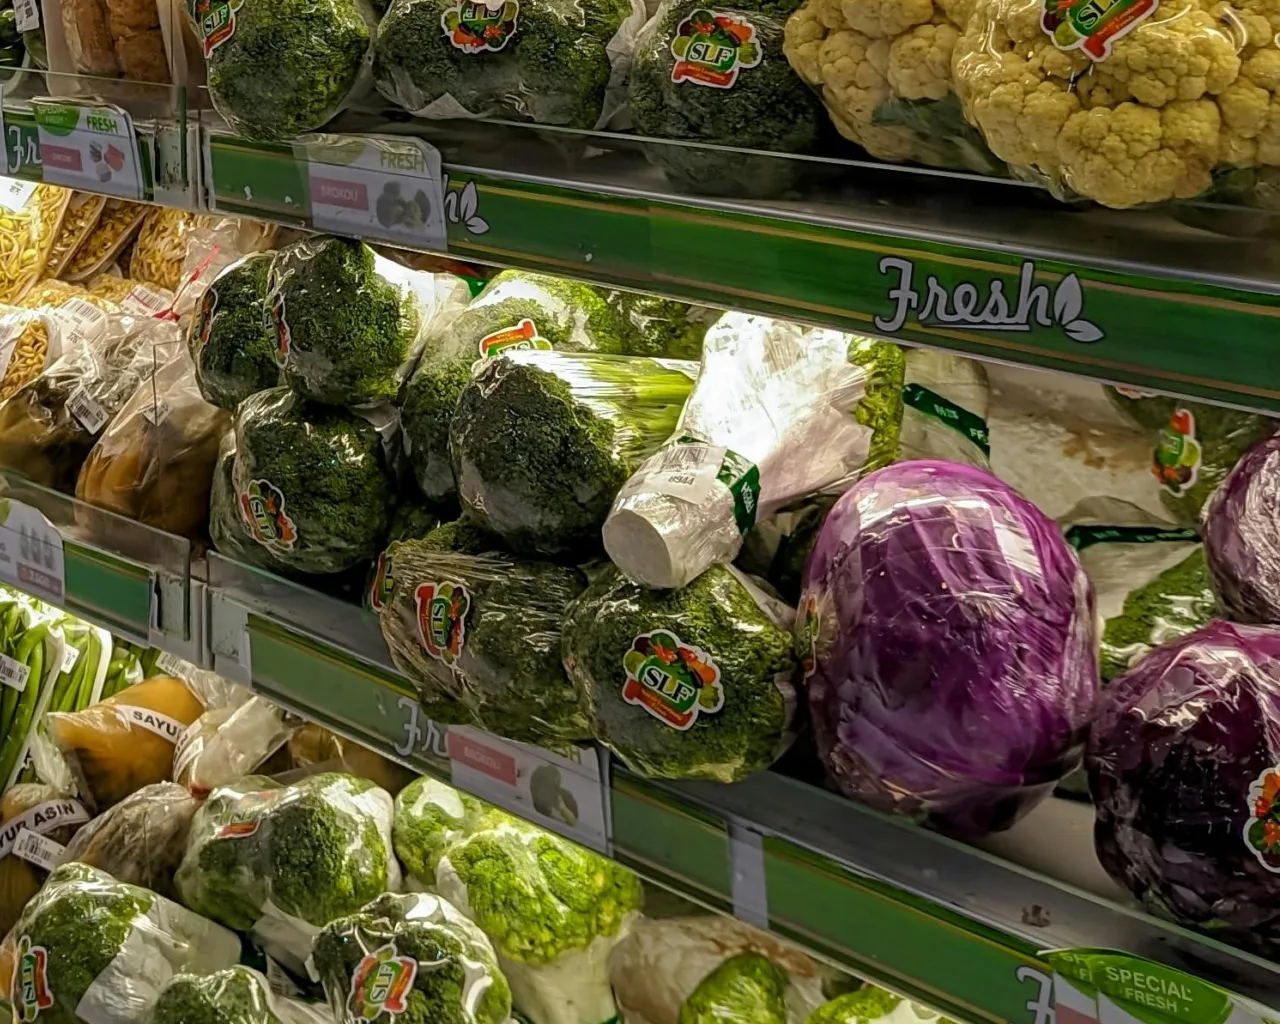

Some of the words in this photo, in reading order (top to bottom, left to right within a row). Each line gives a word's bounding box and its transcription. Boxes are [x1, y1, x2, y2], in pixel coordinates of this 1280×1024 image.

[204, 4, 229, 37] SLF
[688, 42, 734, 66] SLF
[86, 115, 119, 133] FRESH
[380, 151, 425, 172] FRESH
[874, 257, 1053, 332] Fresh
[251, 500, 275, 538] SLF
[432, 603, 446, 646] SLF
[642, 665, 695, 704] SLF
[133, 710, 179, 737] SAYU
[33, 803, 75, 827] ASIN
[370, 963, 395, 1001] SLF
[1104, 965, 1194, 1003] SPECIAL
[1125, 988, 1178, 1014] FRESH
